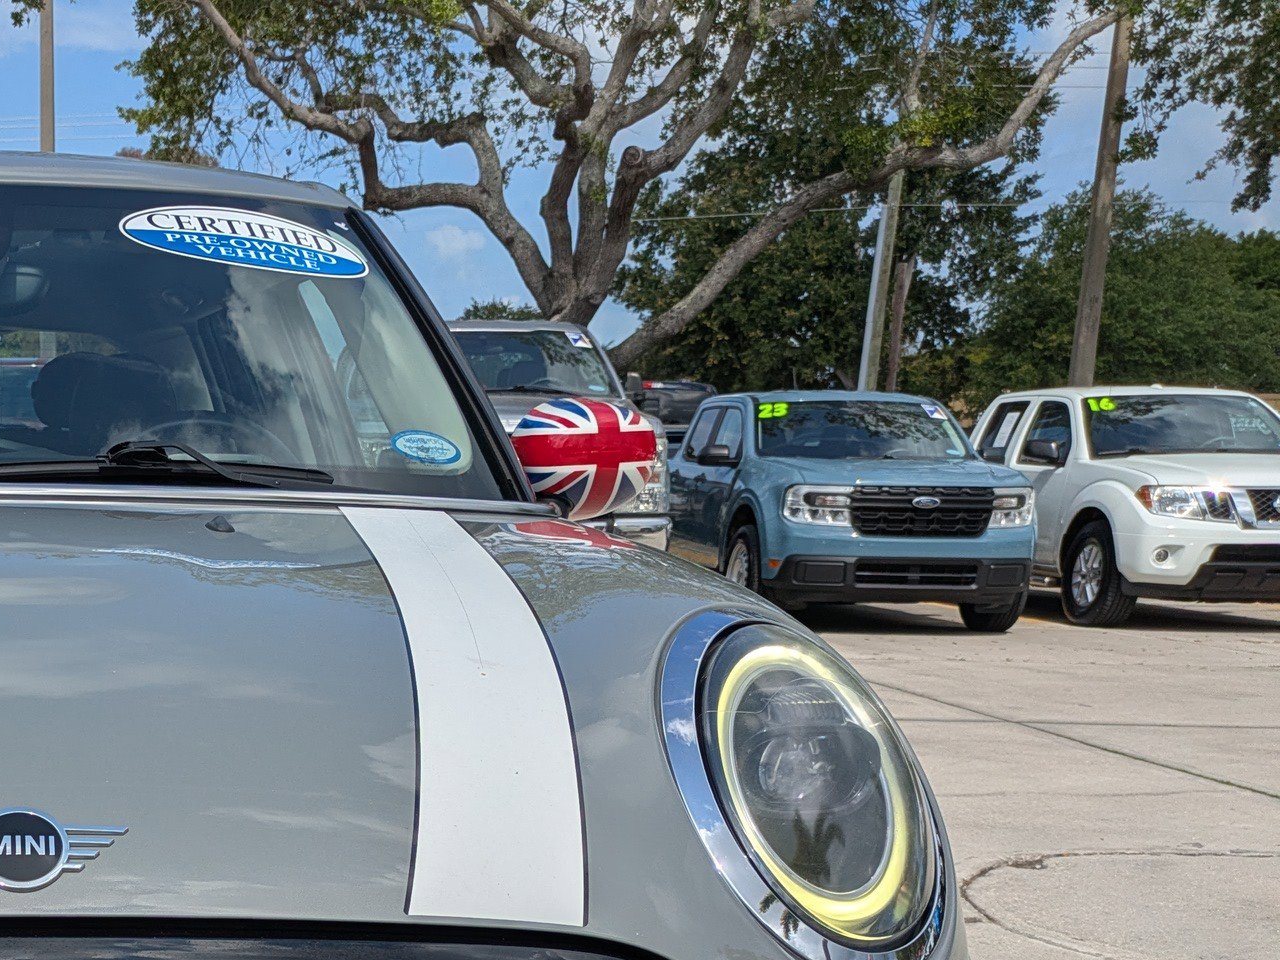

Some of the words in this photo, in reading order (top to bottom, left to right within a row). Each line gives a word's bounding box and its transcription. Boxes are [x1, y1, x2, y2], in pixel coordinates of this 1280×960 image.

[147, 213, 337, 253] CERTIFIED
[164, 233, 337, 265] PRE-OWNED
[197, 244, 321, 271] VEHICLE
[758, 403, 788, 418] 23
[1087, 397, 1116, 411] 16
